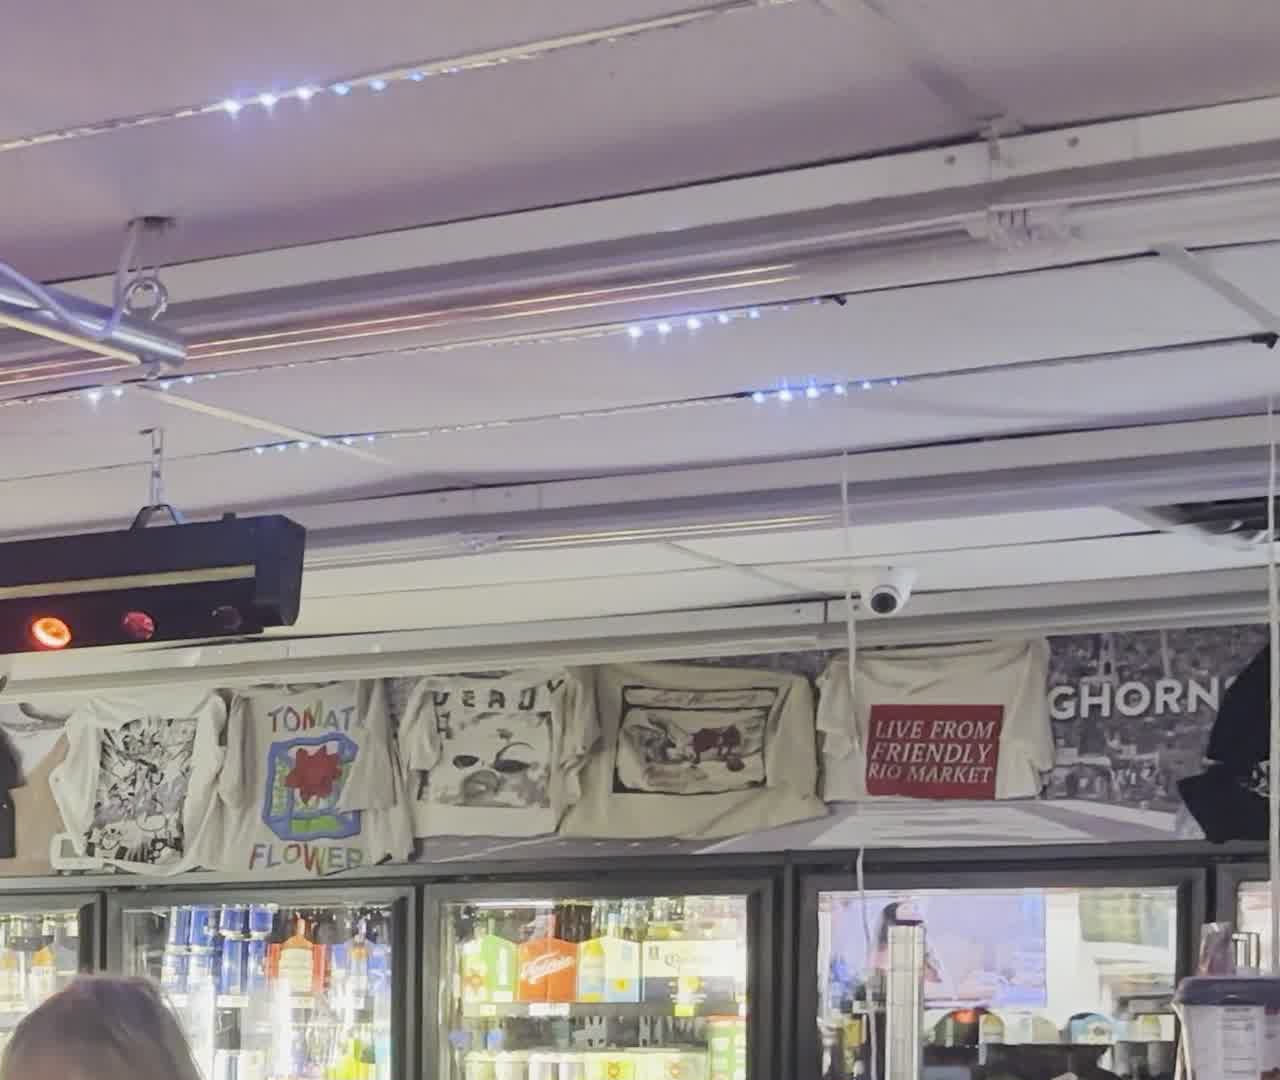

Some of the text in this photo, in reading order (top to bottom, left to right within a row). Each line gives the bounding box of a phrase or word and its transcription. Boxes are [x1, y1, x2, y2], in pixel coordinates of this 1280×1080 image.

[1048, 677, 1237, 720] GHORN
[268, 703, 364, 733] TOMAT
[876, 720, 994, 740] LIVE FROM
[871, 742, 992, 765] FRIENDLY
[910, 766, 993, 783] MARKET
